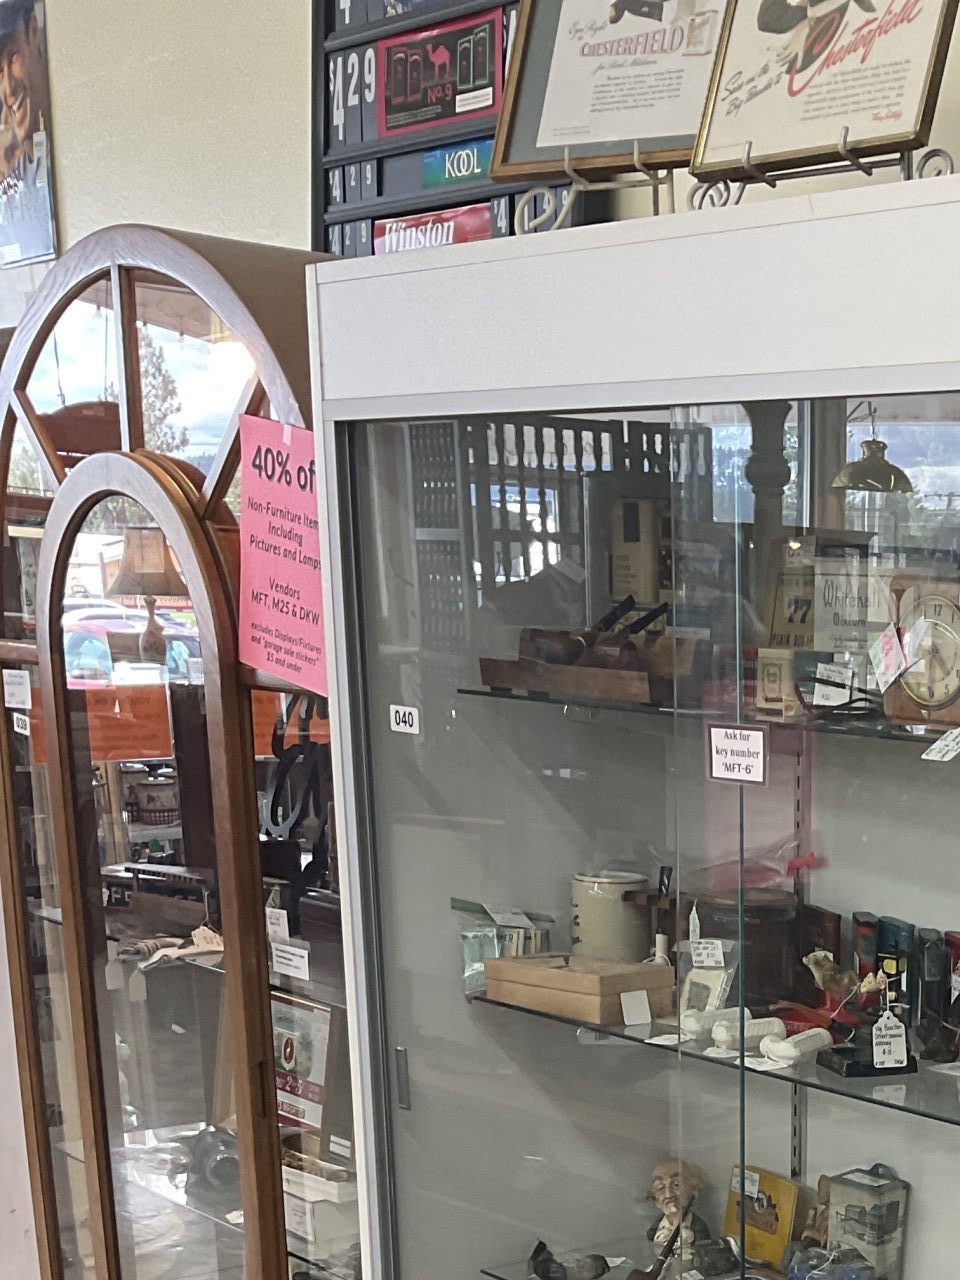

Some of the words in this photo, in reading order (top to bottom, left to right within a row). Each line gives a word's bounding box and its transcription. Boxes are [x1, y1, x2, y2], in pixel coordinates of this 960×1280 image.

[579, 25, 685, 57] CHESTERFIELD
[444, 149, 482, 179] KOOL
[385, 217, 455, 254] Winston
[252, 445, 292, 487] 40%
[248, 496, 302, 525] Non-Furniture
[250, 534, 281, 556] Pictures
[283, 547, 297, 561] and
[268, 521, 303, 547] Including
[269, 577, 300, 600] Vendors
[251, 589, 270, 611] MFT,
[272, 597, 290, 615] M25
[291, 604, 297, 618] &
[299, 606, 320, 626] DKW
[15, 715, 27, 731] 039
[395, 710, 414, 728] 040
[724, 730, 738, 740] Ask
[739, 731, 751, 741] for
[715, 745, 728, 758] key
[730, 748, 760, 759] number
